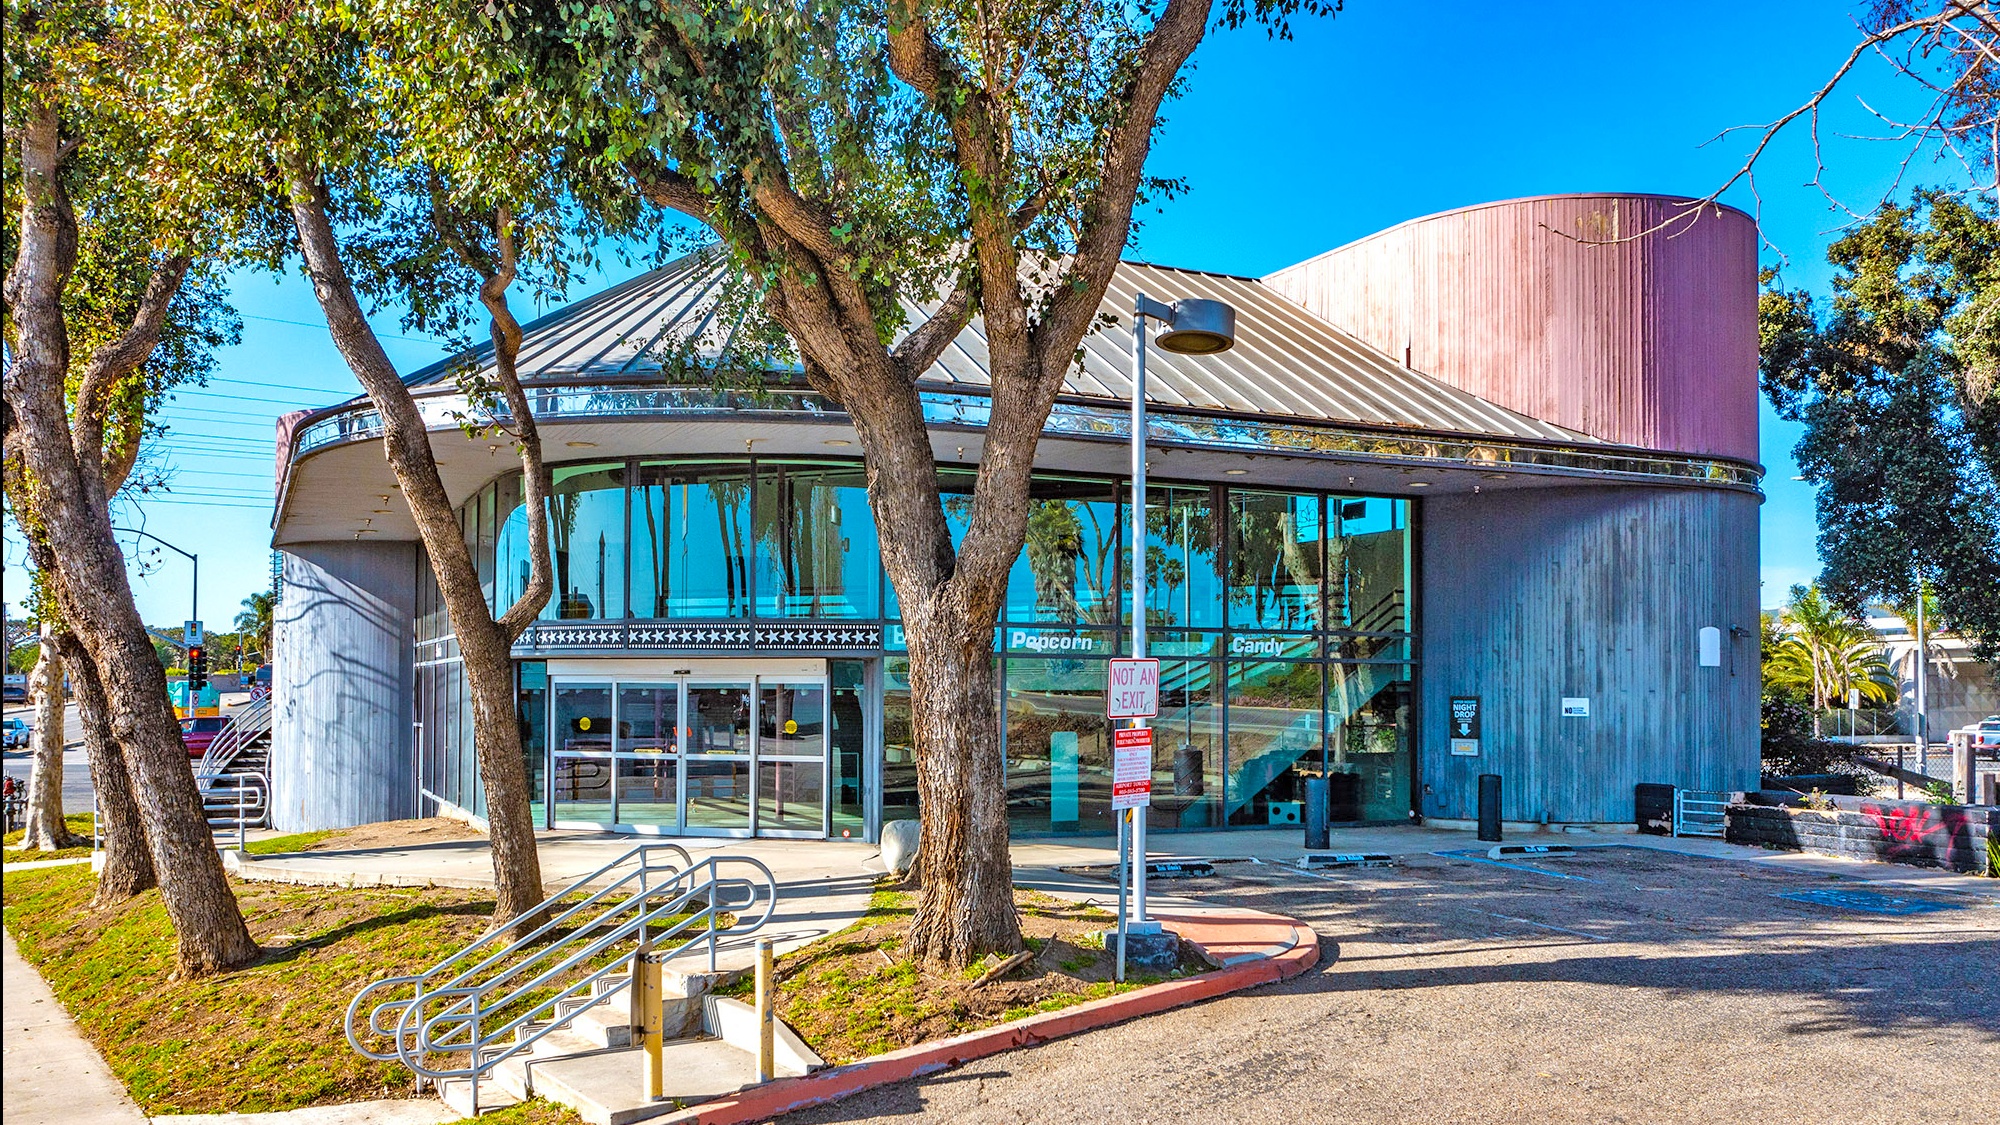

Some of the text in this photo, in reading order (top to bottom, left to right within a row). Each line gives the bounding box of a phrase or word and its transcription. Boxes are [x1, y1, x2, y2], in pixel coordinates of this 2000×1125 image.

[1011, 631, 1093, 653] Popcorn
[1232, 636, 1285, 657] Candy
[1112, 667, 1156, 686] NOT AN
[1121, 690, 1146, 709] EXIT
[1452, 703, 1477, 711] NIGHT
